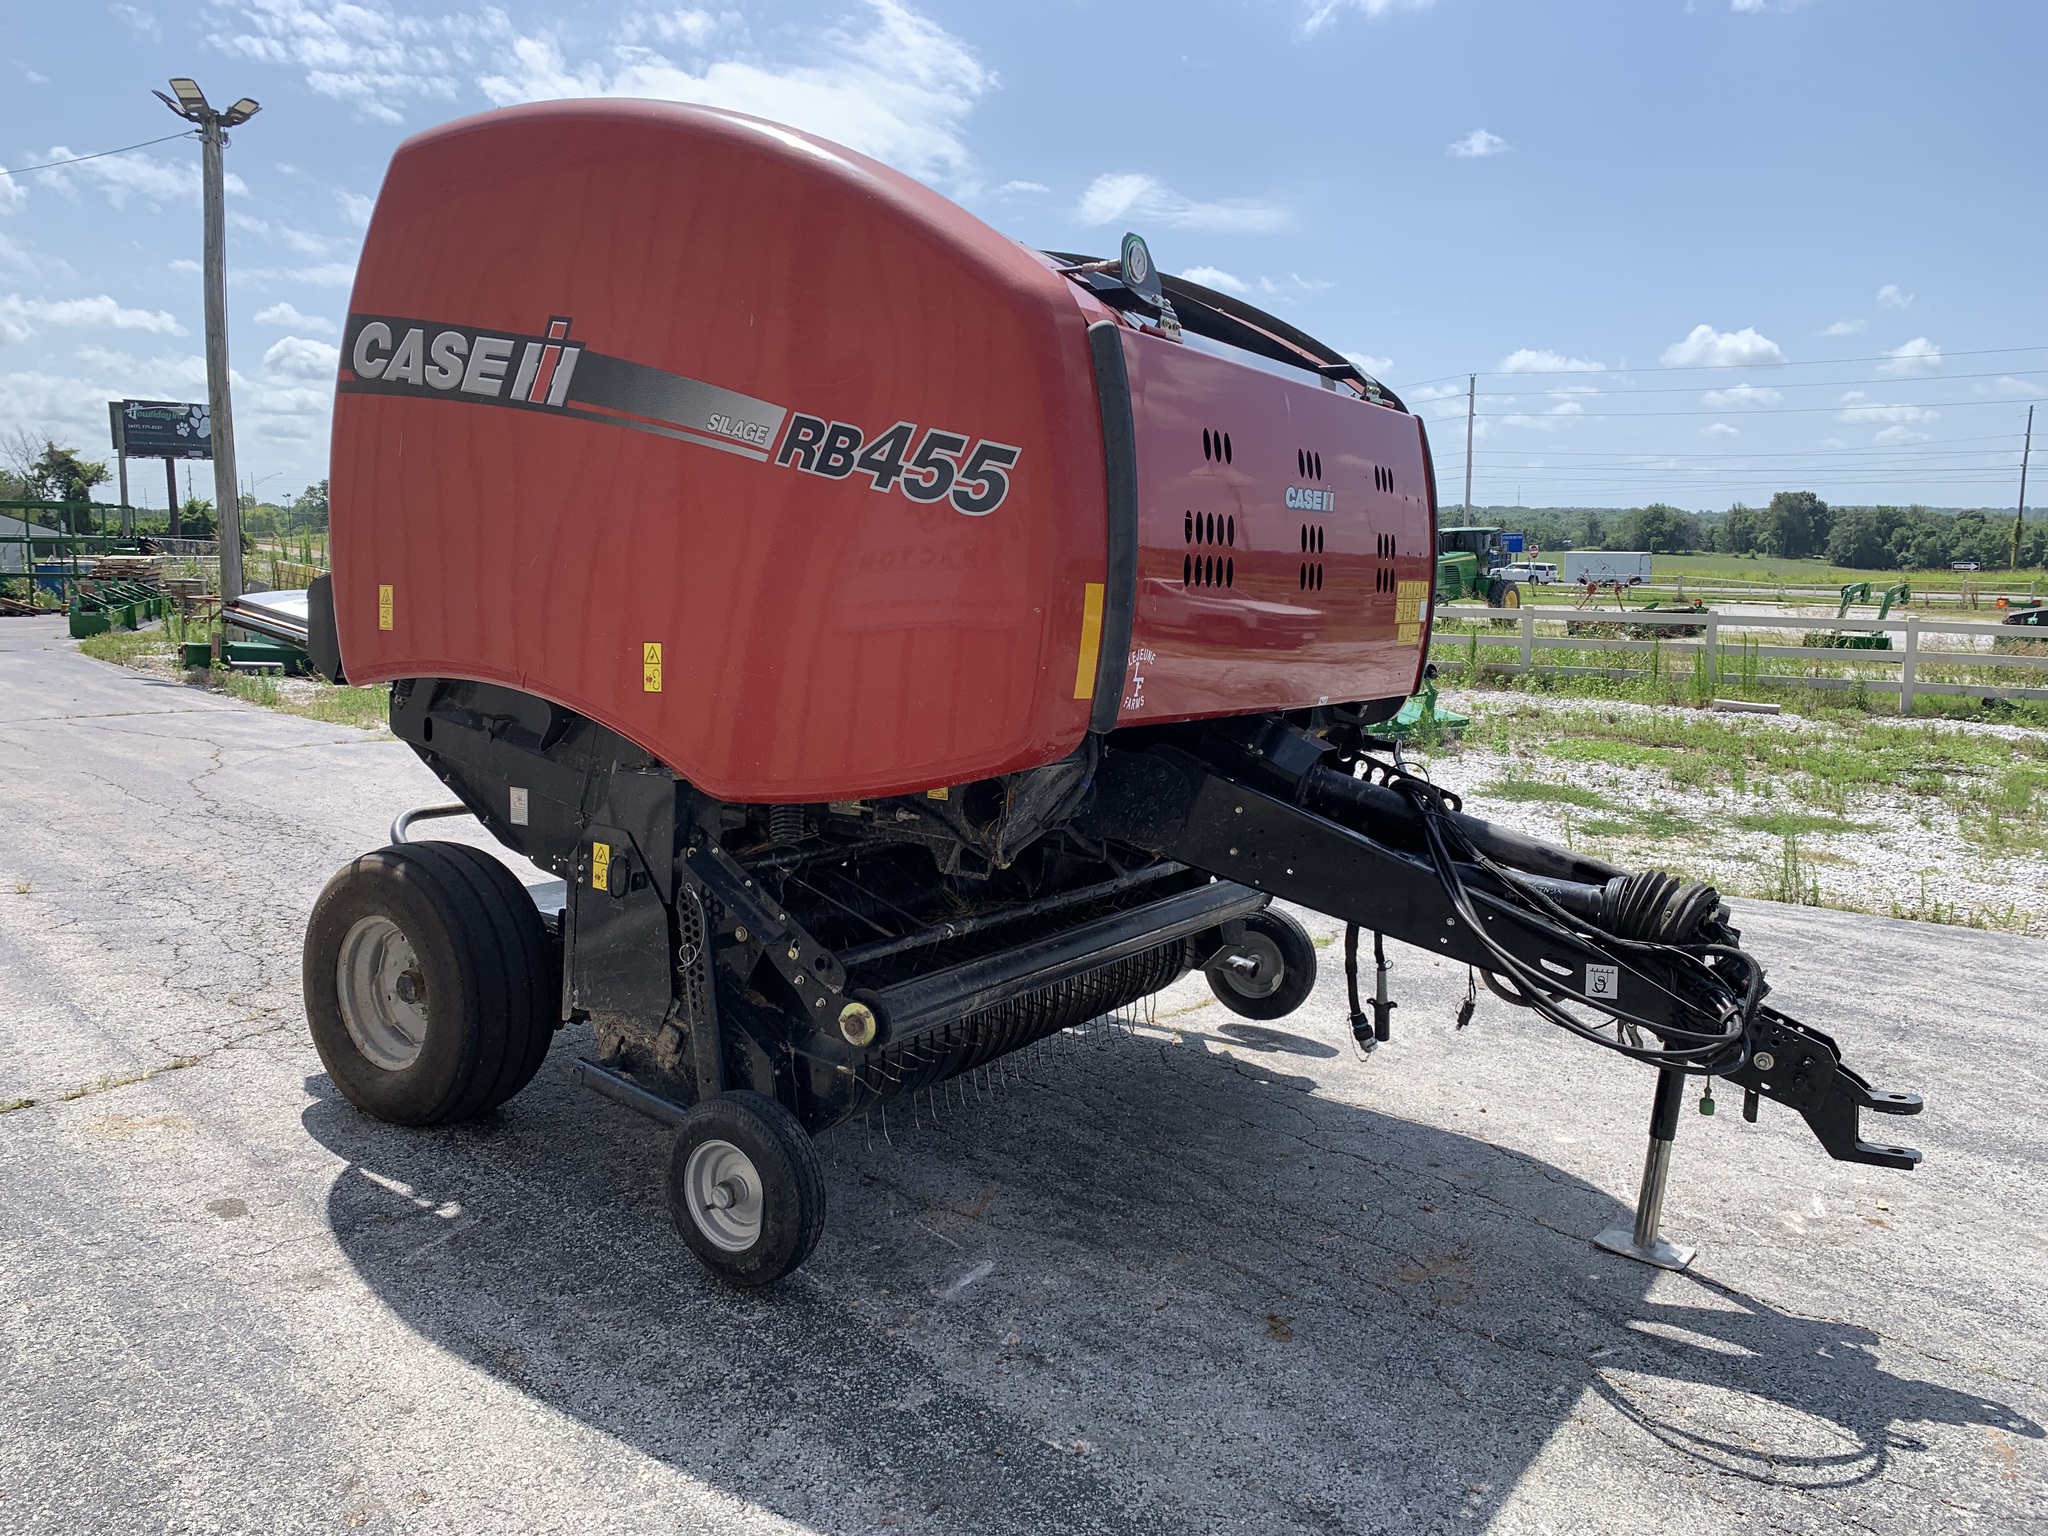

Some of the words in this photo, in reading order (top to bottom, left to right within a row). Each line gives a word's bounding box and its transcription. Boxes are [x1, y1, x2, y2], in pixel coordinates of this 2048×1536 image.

[353, 321, 515, 397] CASE
[706, 413, 770, 445] SILAGE
[774, 411, 1023, 517] RB455
[1285, 486, 1322, 510] CASE
[1127, 648, 1156, 667] LEJEUNE
[1123, 695, 1145, 710] FARMS
